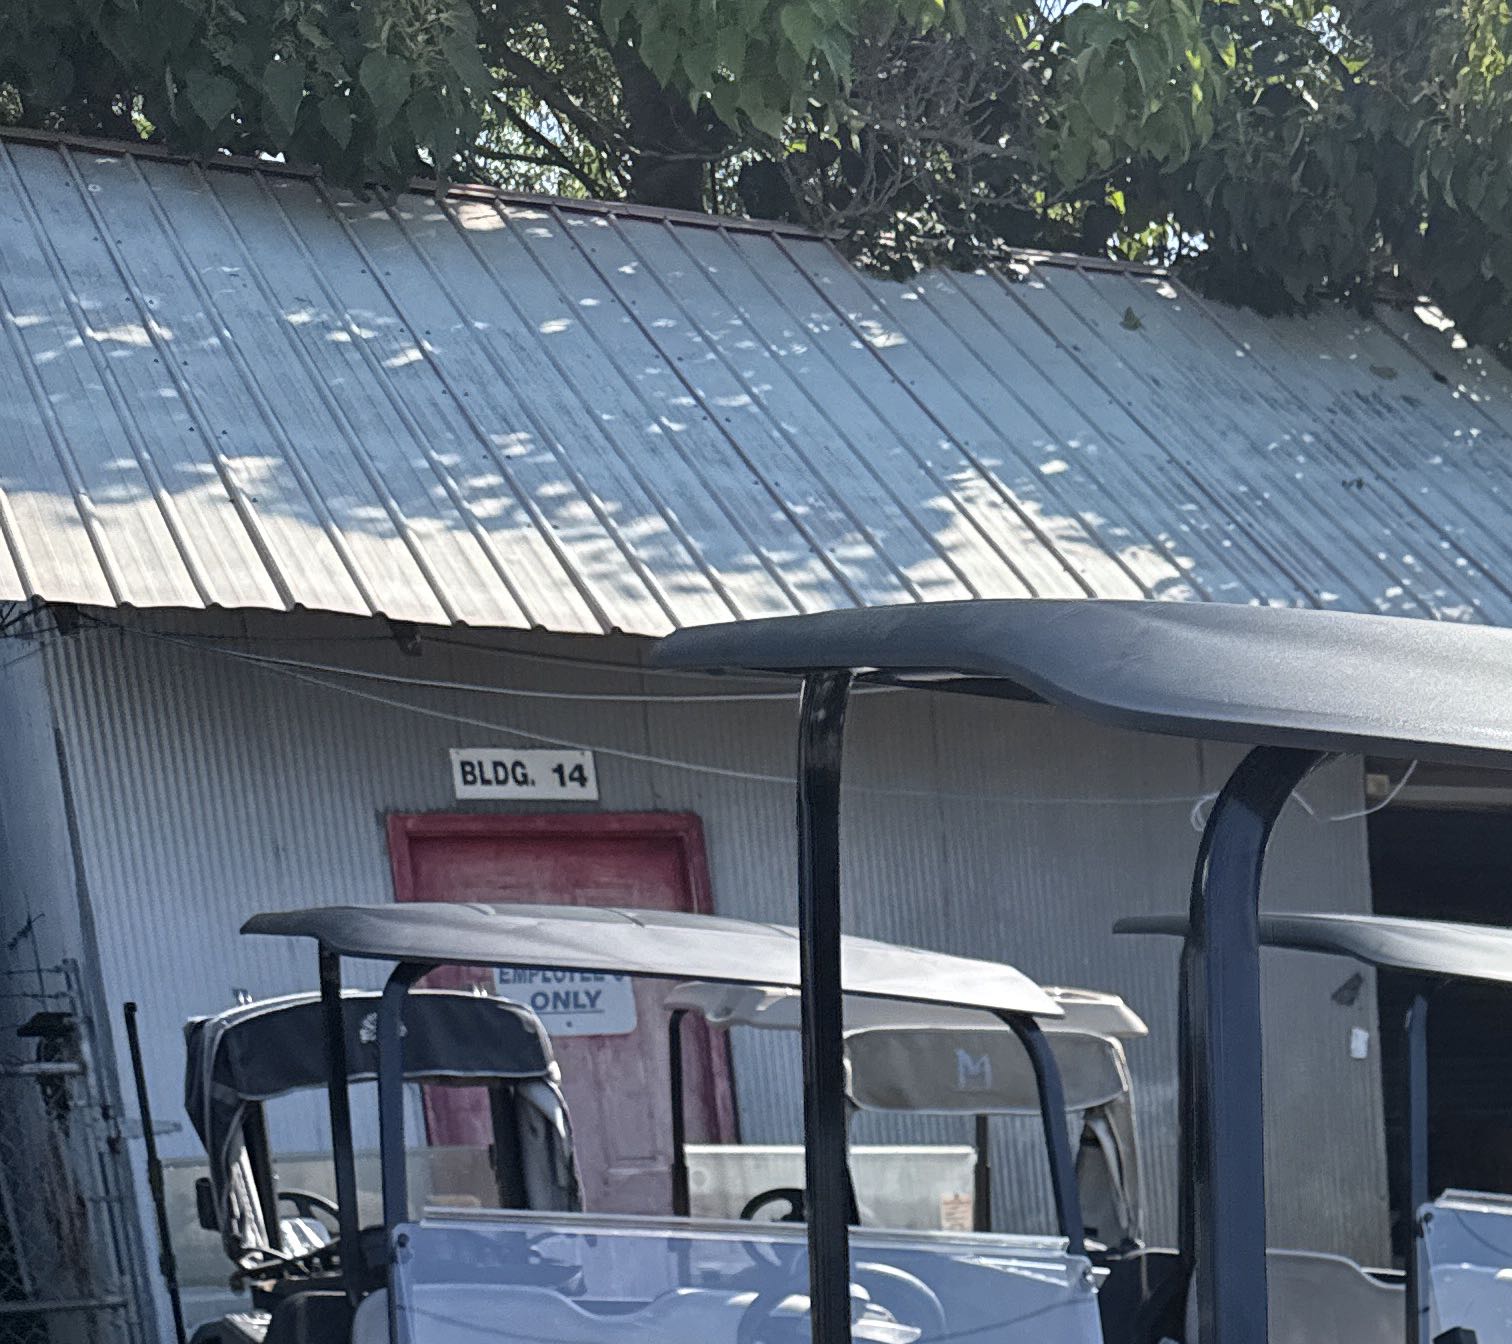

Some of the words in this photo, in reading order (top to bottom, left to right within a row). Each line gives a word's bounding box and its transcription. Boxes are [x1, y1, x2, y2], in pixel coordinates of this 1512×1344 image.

[460, 760, 535, 787] BLDG.
[552, 763, 588, 788] 14
[530, 989, 602, 1010] ONLY
